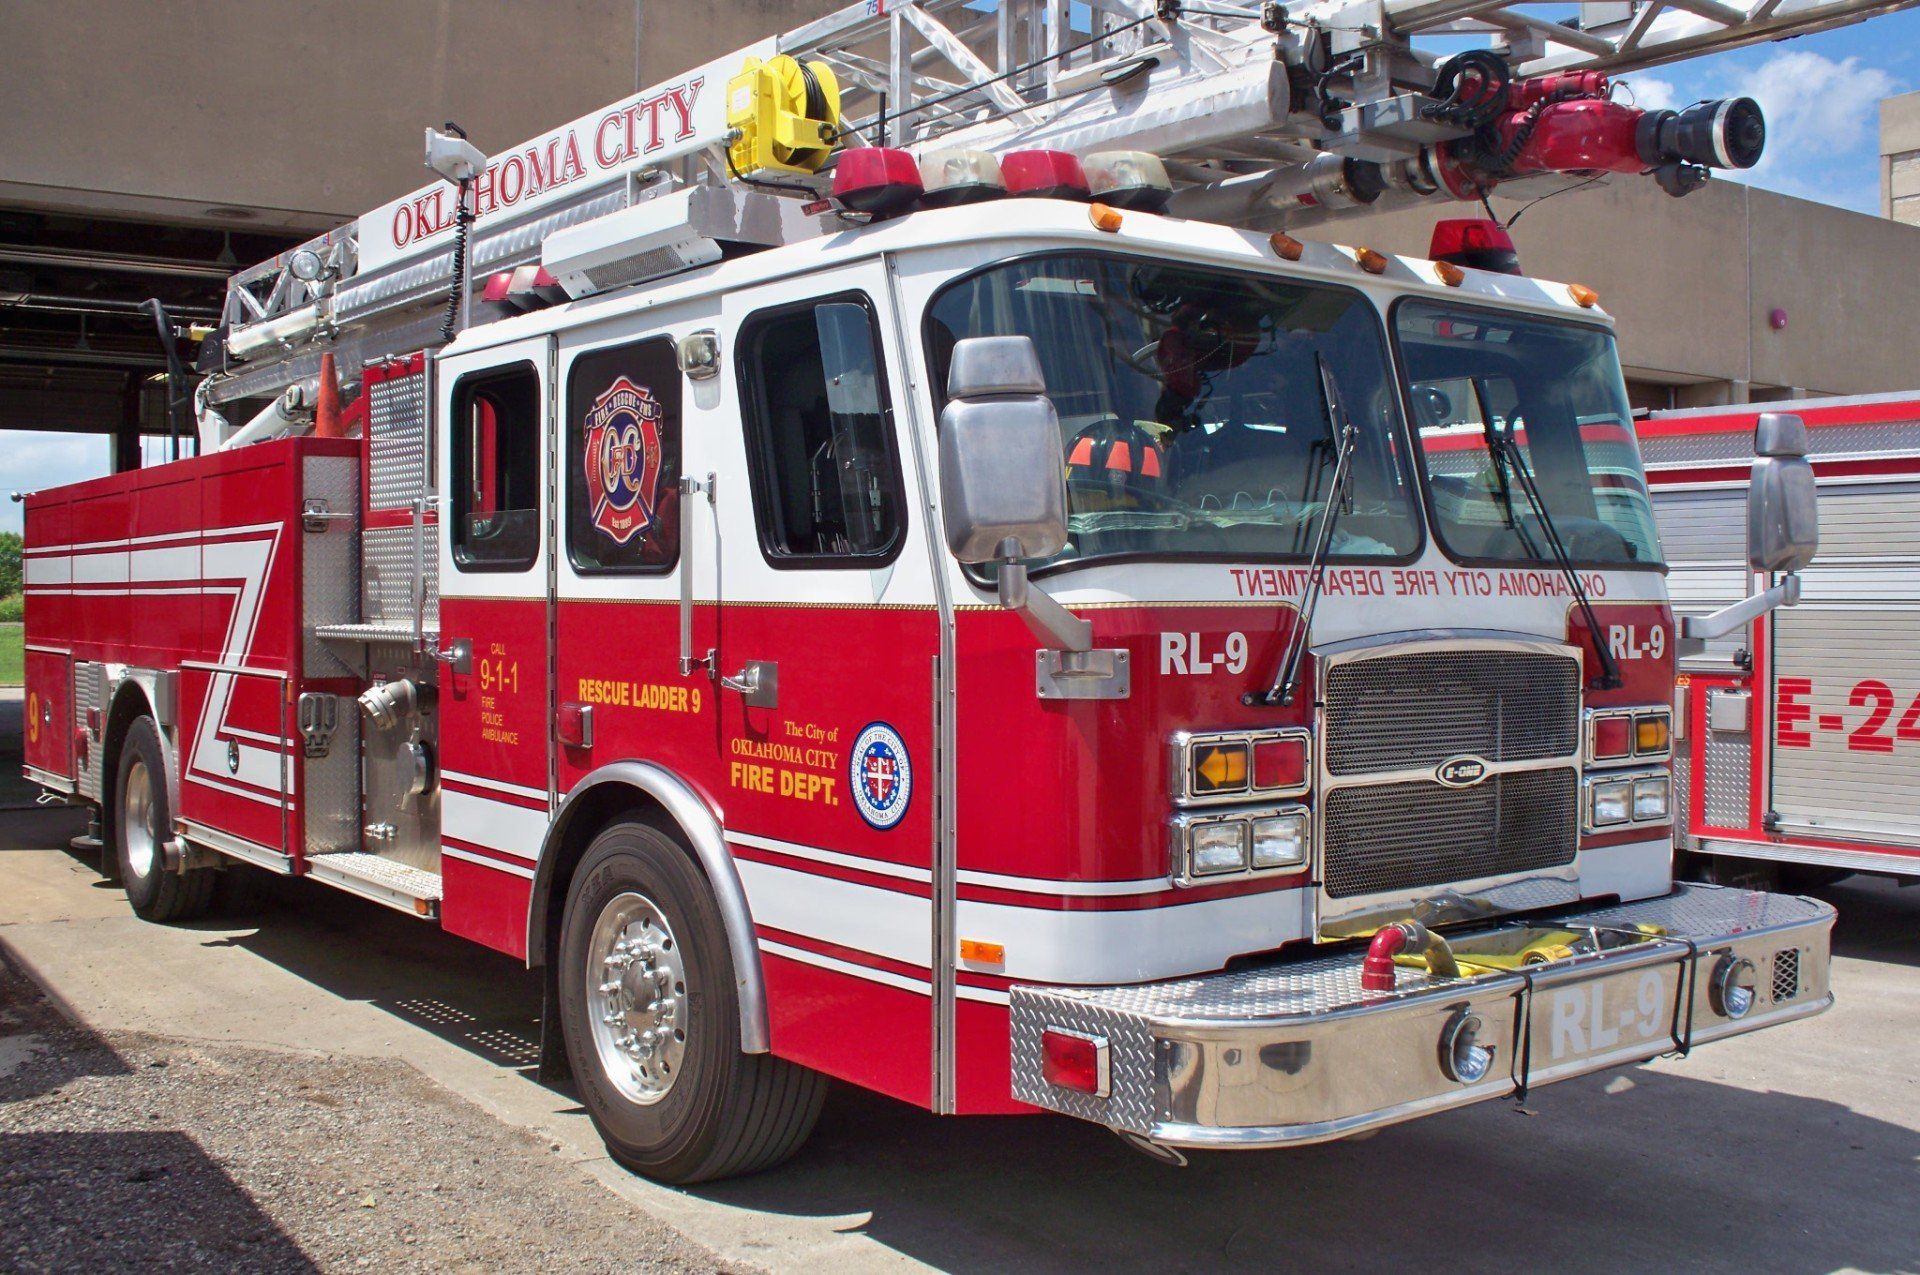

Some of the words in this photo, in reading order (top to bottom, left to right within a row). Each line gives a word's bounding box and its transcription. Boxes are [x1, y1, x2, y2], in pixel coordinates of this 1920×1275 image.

[593, 75, 705, 170] CITY
[594, 404, 609, 427] FIRE
[612, 391, 637, 409] RESCUE
[491, 642, 506, 656] CALL
[1160, 631, 1248, 675] RL-9
[1609, 624, 1665, 660] RL-9
[481, 658, 518, 694] 9-1-1
[482, 696, 495, 709] FIRE
[578, 679, 629, 705] RESCUE
[632, 684, 688, 713] LADDER
[691, 688, 701, 714] 9
[30, 692, 38, 743] 9
[482, 712, 503, 727] POLICE
[784, 720, 803, 737] The
[805, 723, 825, 745] City
[827, 727, 839, 743] of
[482, 728, 519, 746] AMBULANCE
[731, 738, 802, 764] OKLAHOMA
[805, 748, 839, 770] CITY
[731, 762, 774, 793] FIRE
[780, 770, 838, 805] DEPT.
[1445, 764, 1482, 779] E-ONE
[1551, 970, 1664, 1060] RL-9
